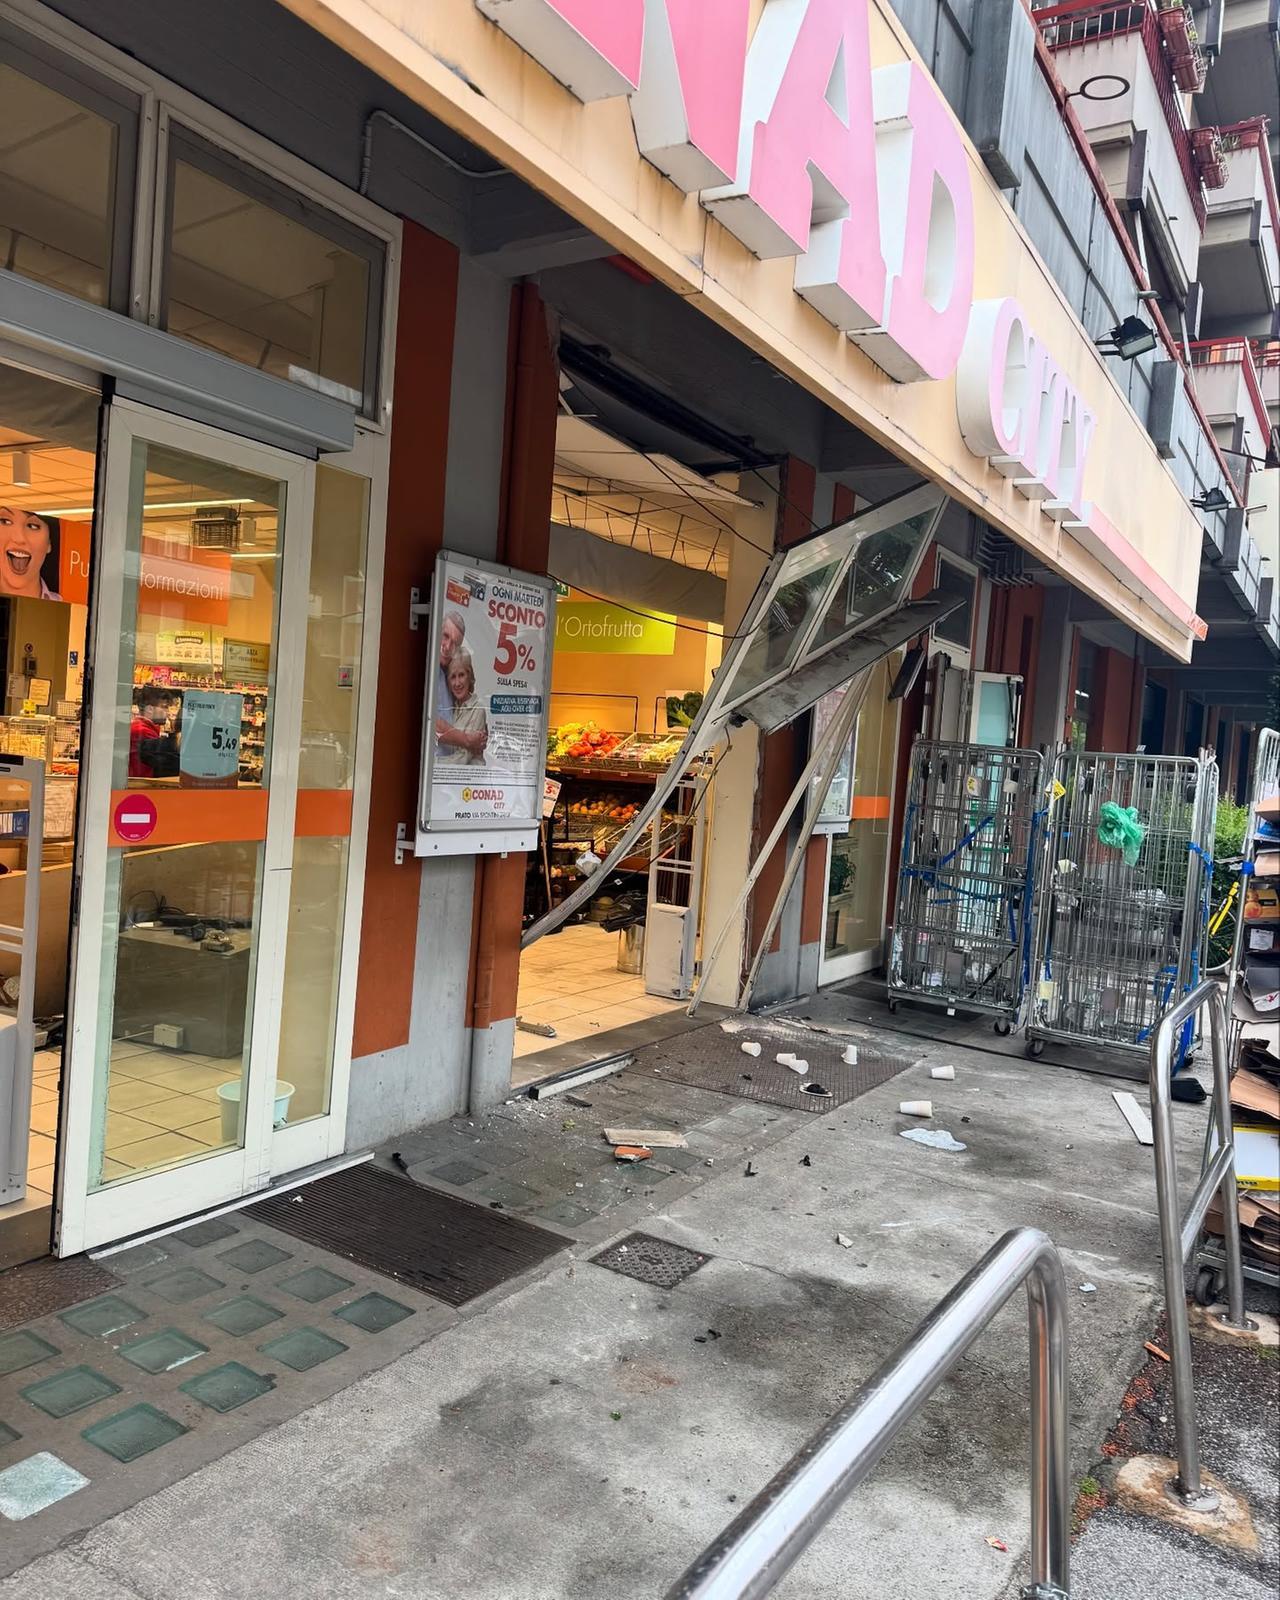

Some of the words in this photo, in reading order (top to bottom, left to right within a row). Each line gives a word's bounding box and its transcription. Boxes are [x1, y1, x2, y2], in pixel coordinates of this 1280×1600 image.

[966, 297, 1098, 522] CITY
[492, 585, 513, 601] OGNI
[488, 599, 546, 629] SCONTO
[556, 614, 643, 638] l'Ortofrutta
[493, 621, 536, 676] 5%
[497, 677, 512, 686] SULLA
[512, 679, 528, 688] SPESA
[472, 789, 504, 801] CONAD
